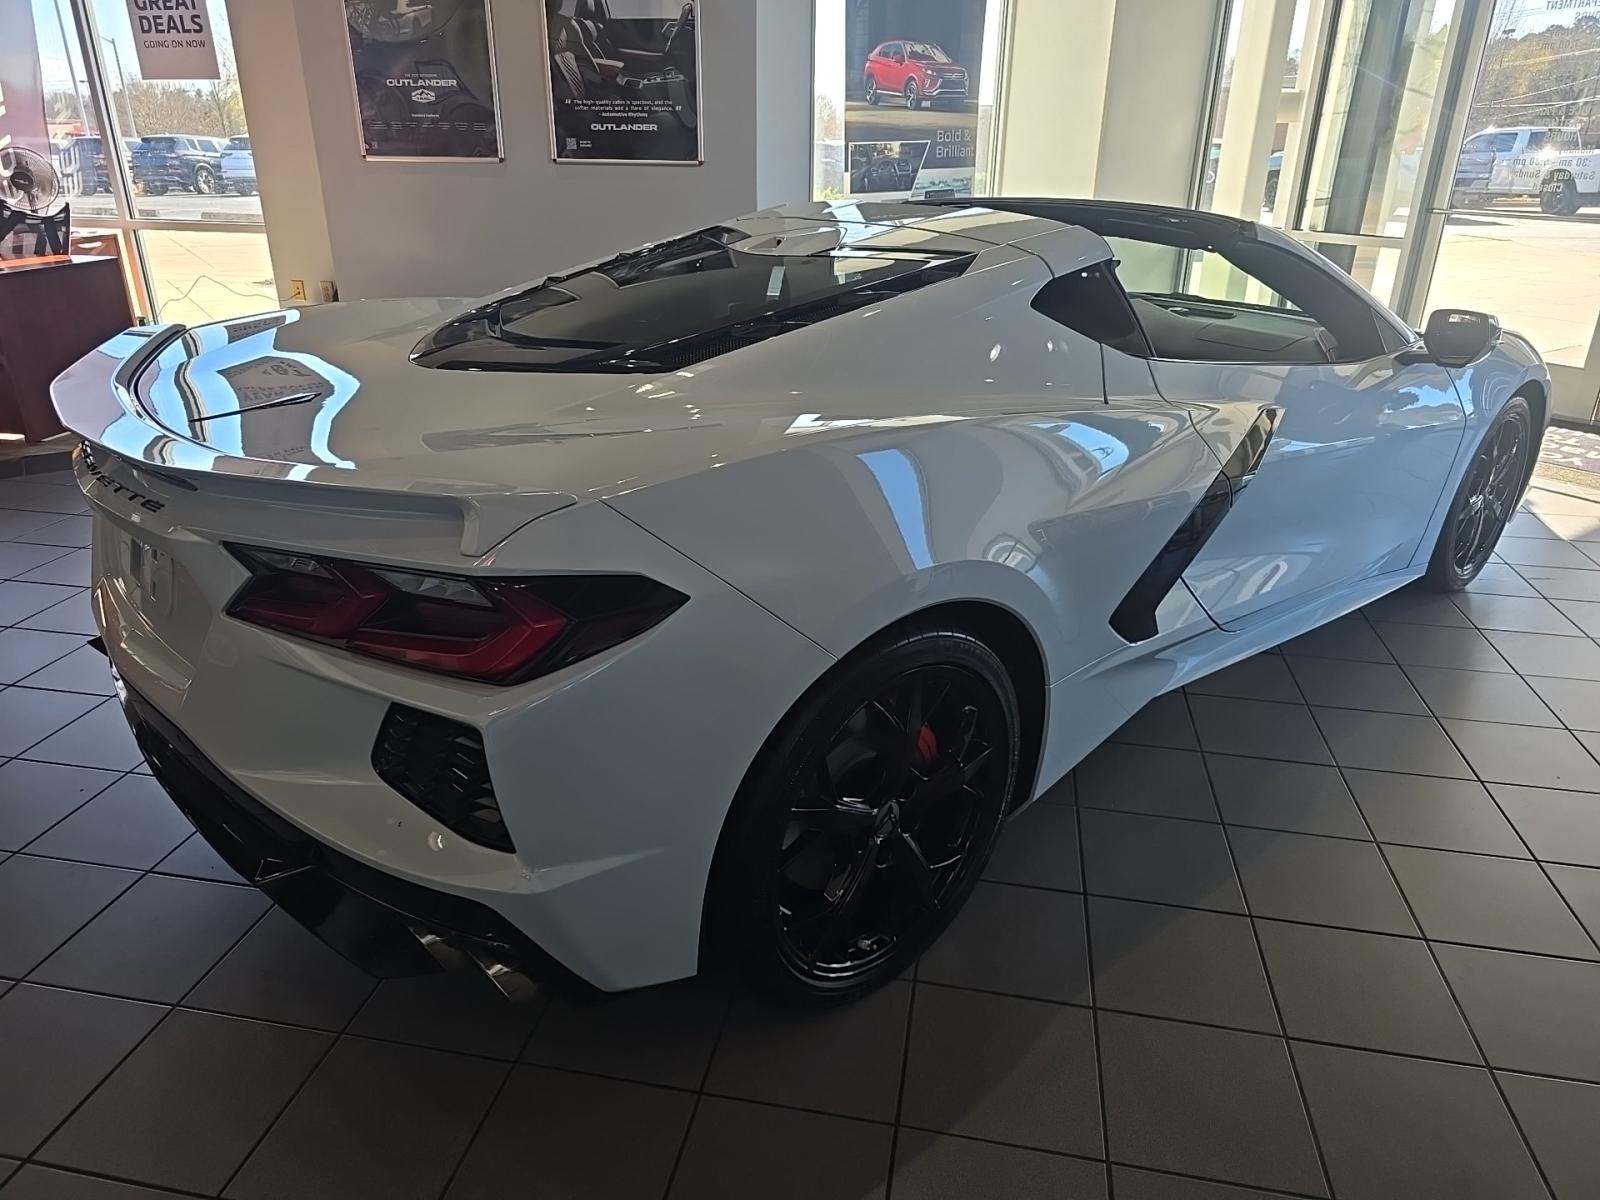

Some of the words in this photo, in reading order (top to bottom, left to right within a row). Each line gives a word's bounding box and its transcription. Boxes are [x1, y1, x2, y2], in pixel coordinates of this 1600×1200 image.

[134, 0, 197, 11] GREAT
[138, 14, 204, 34] DEALS
[143, 40, 170, 49] GOING
[171, 40, 184, 48] ON
[185, 40, 206, 48] NOW
[386, 79, 458, 87] OUTLANDER
[590, 123, 658, 131] OUTLANDER
[936, 129, 962, 142] Bold
[964, 130, 973, 141] &
